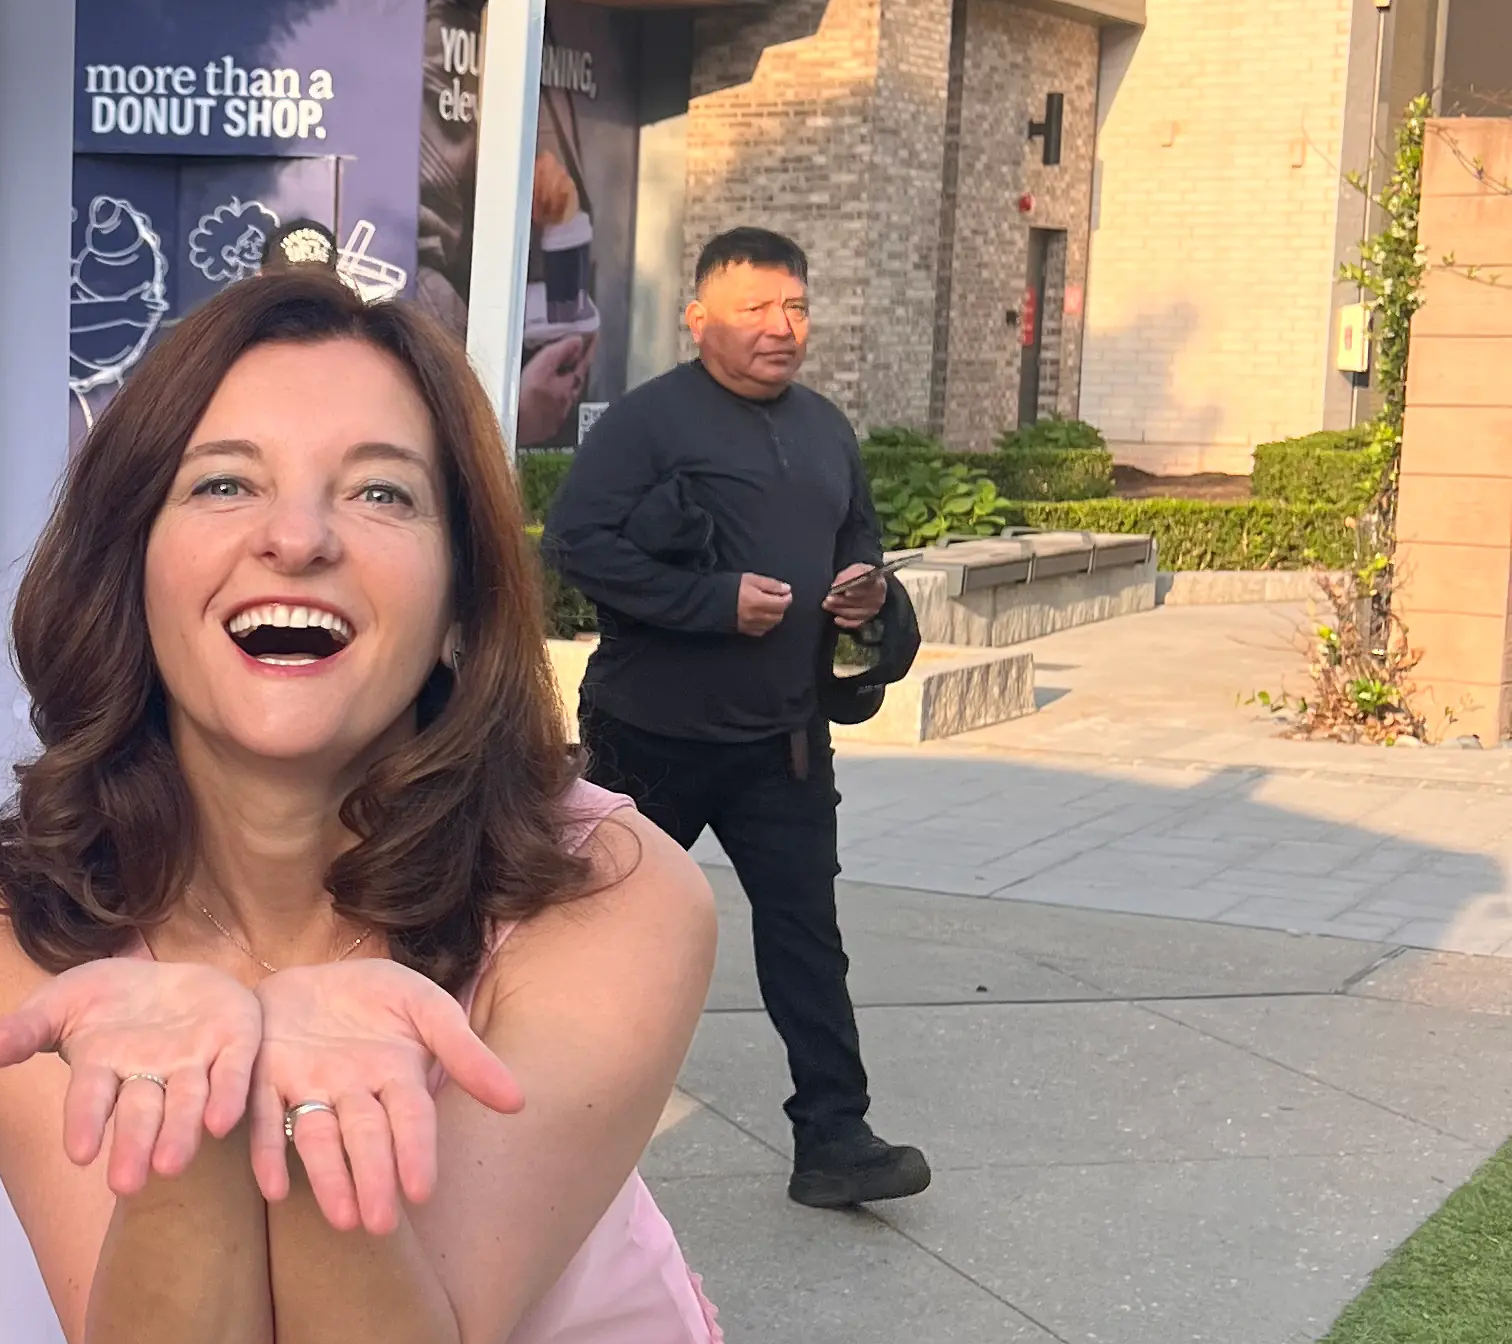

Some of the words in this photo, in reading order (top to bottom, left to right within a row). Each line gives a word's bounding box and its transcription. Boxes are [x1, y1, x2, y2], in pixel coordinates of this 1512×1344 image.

[440, 26, 479, 77] YOU
[84, 64, 197, 95] more
[204, 54, 303, 99] than
[308, 68, 335, 100] a
[91, 96, 218, 136] DONUT
[223, 99, 327, 139] SHOP.
